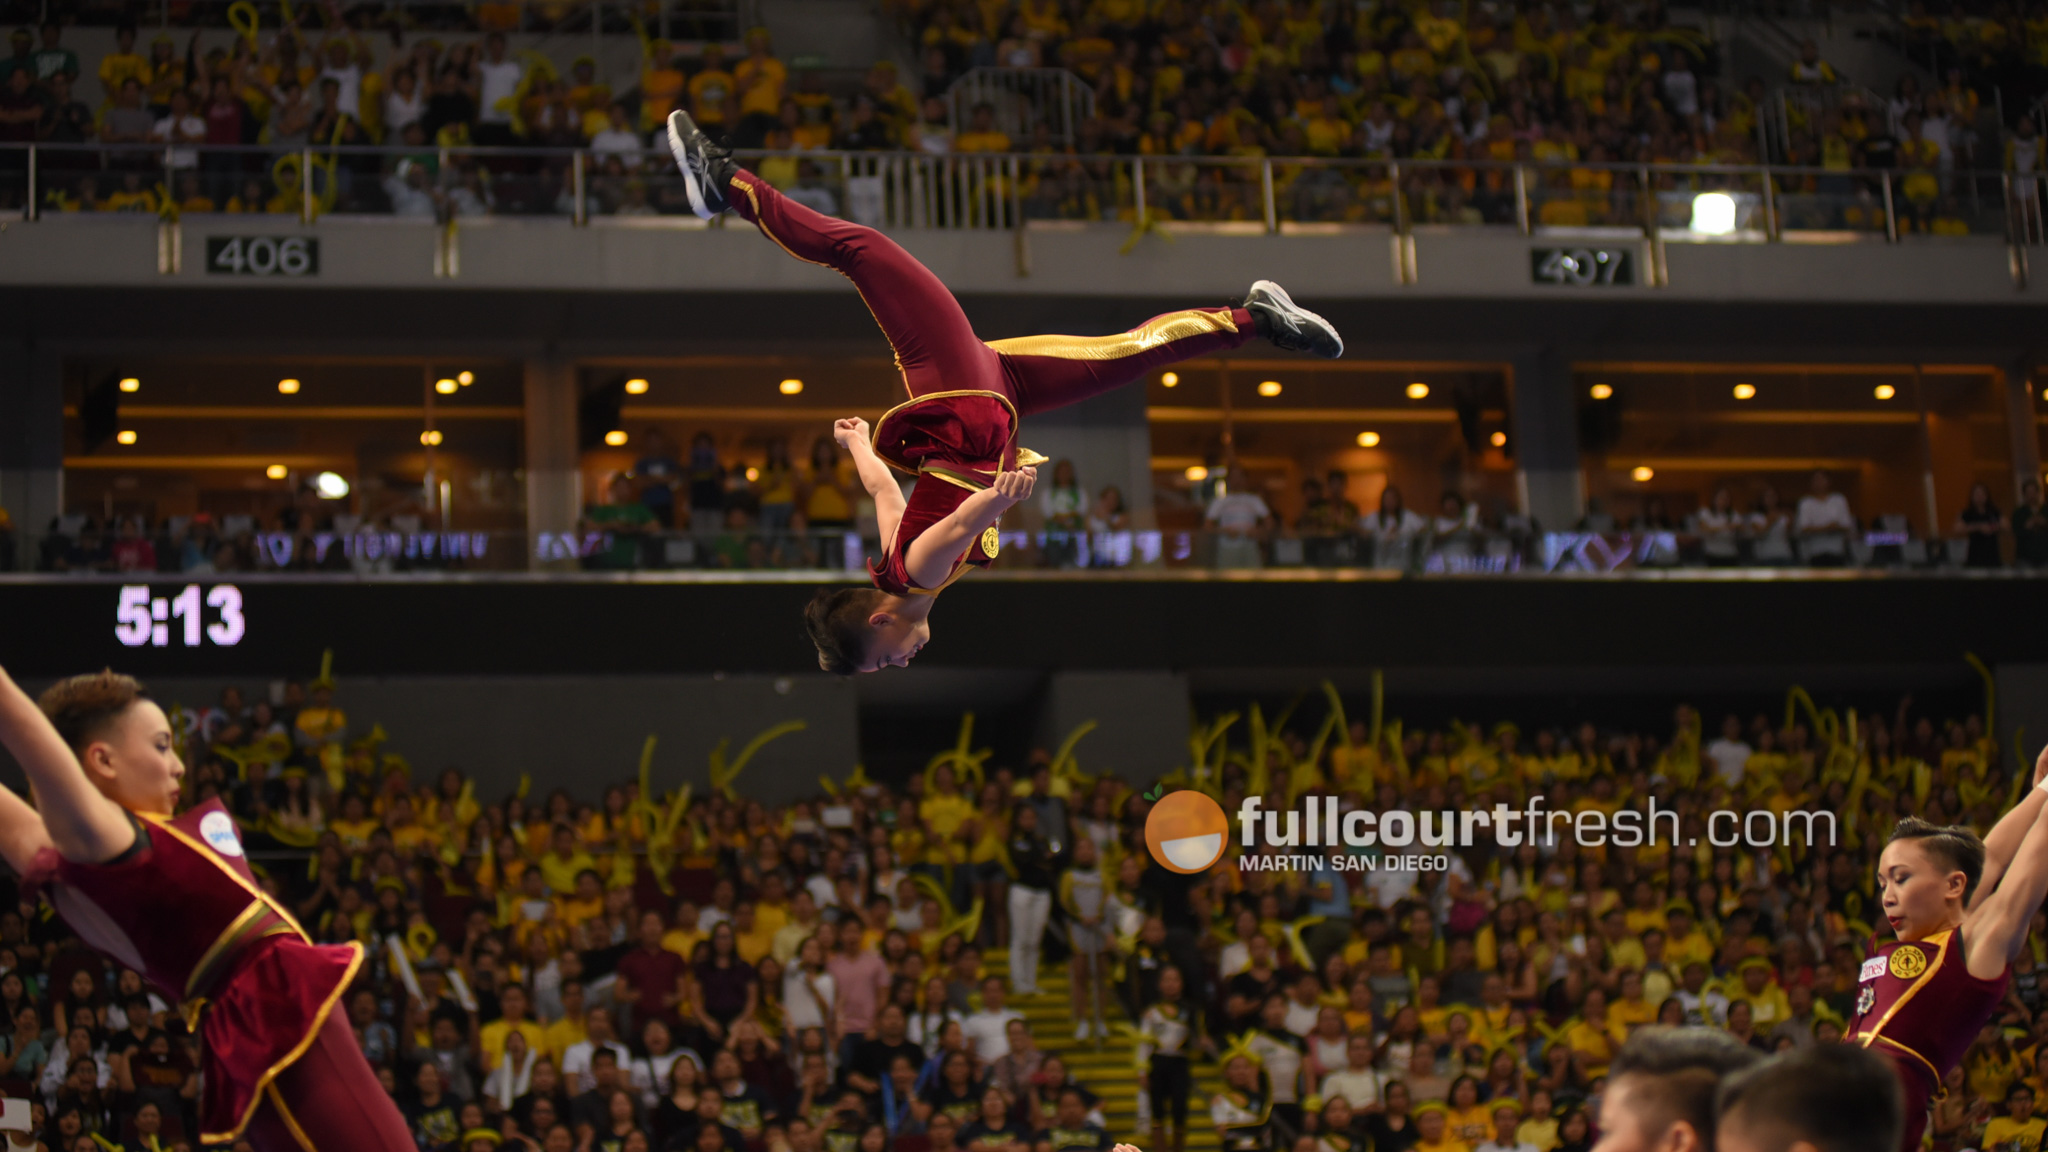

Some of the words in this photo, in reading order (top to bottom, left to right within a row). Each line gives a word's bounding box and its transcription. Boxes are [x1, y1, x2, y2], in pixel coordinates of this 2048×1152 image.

[215, 237, 311, 275] 406
[1539, 249, 1624, 284] 407
[115, 583, 246, 648] 5:13
